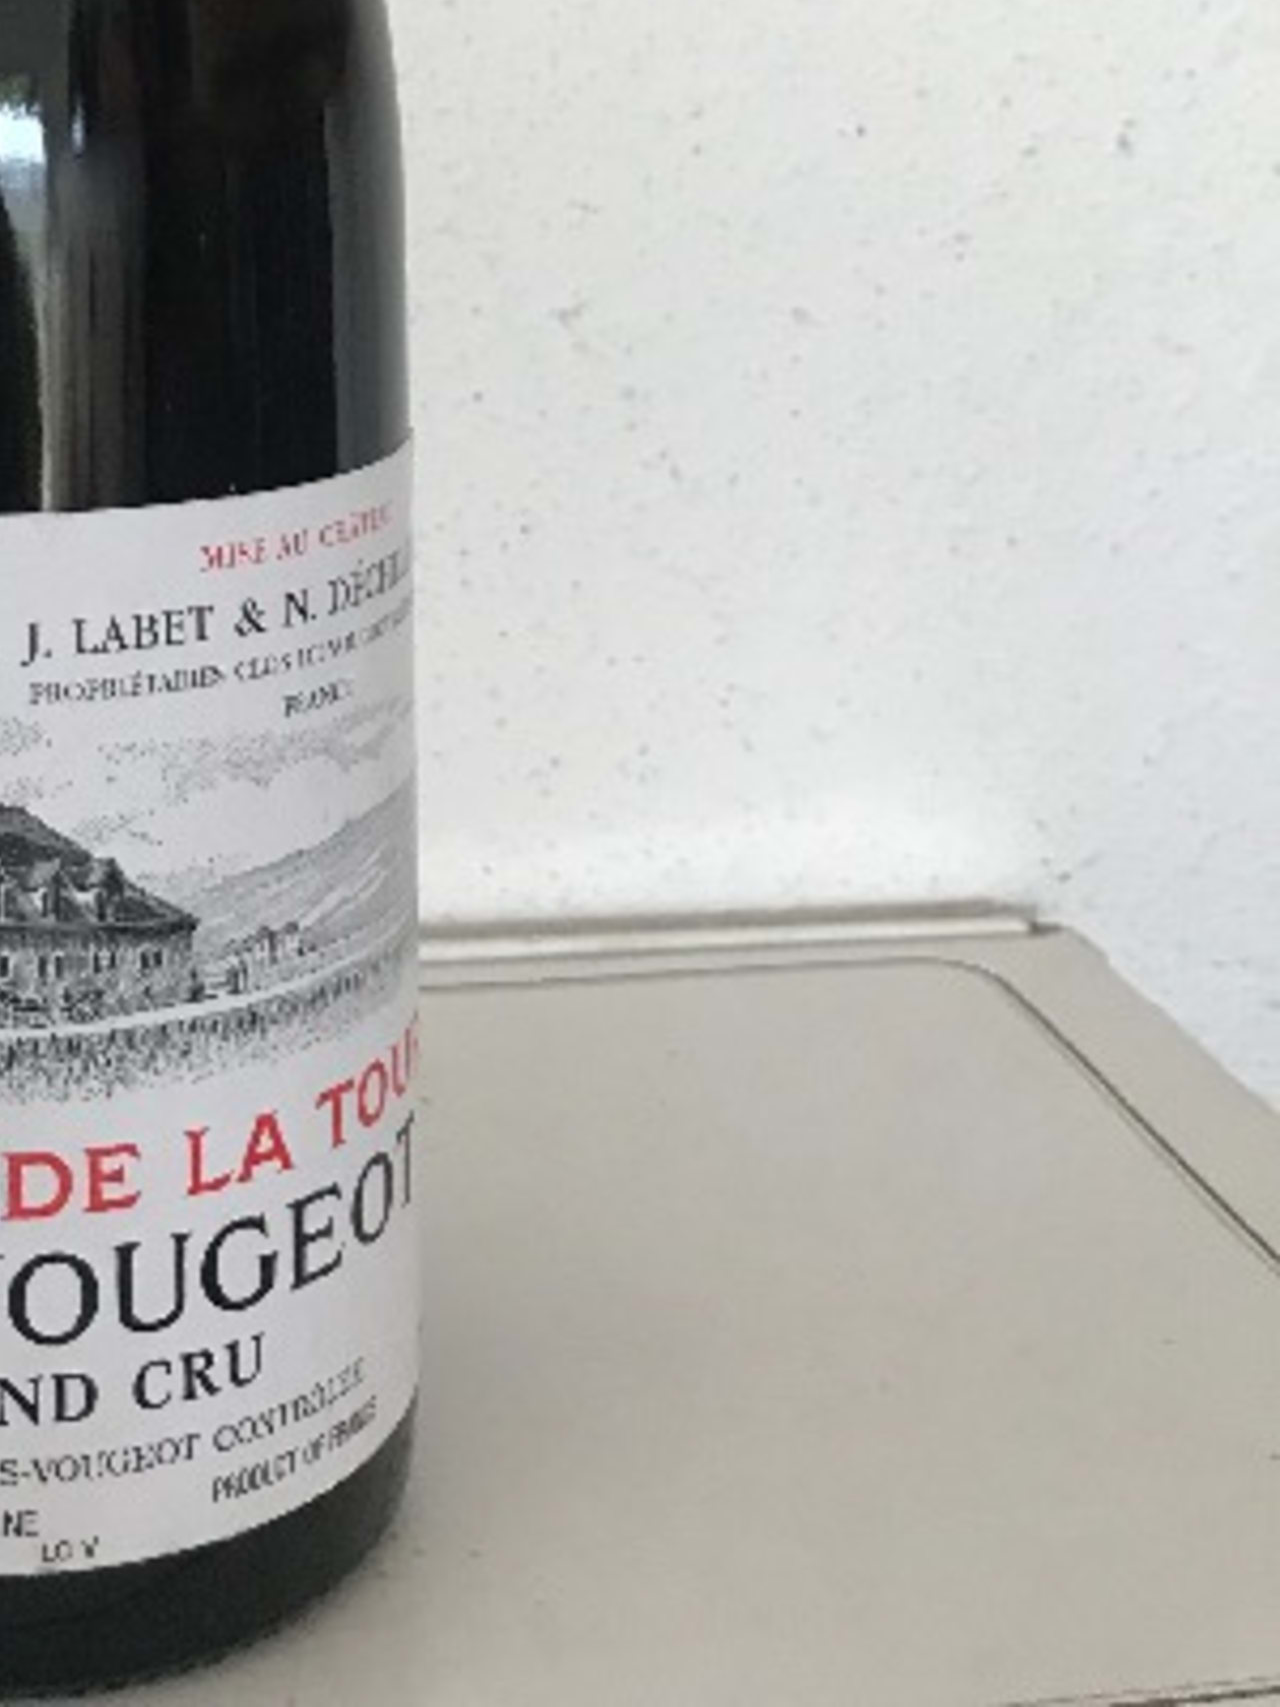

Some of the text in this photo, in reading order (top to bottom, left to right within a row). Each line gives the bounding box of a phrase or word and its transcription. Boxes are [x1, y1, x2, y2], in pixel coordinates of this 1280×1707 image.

[276, 528, 309, 561] AU
[20, 622, 53, 668] J.
[72, 605, 216, 656] LABET
[234, 597, 267, 637] &
[282, 588, 317, 629] N.
[0, 1142, 142, 1221] DE
[184, 1108, 295, 1197] LA
[131, 1332, 266, 1411] CRU
